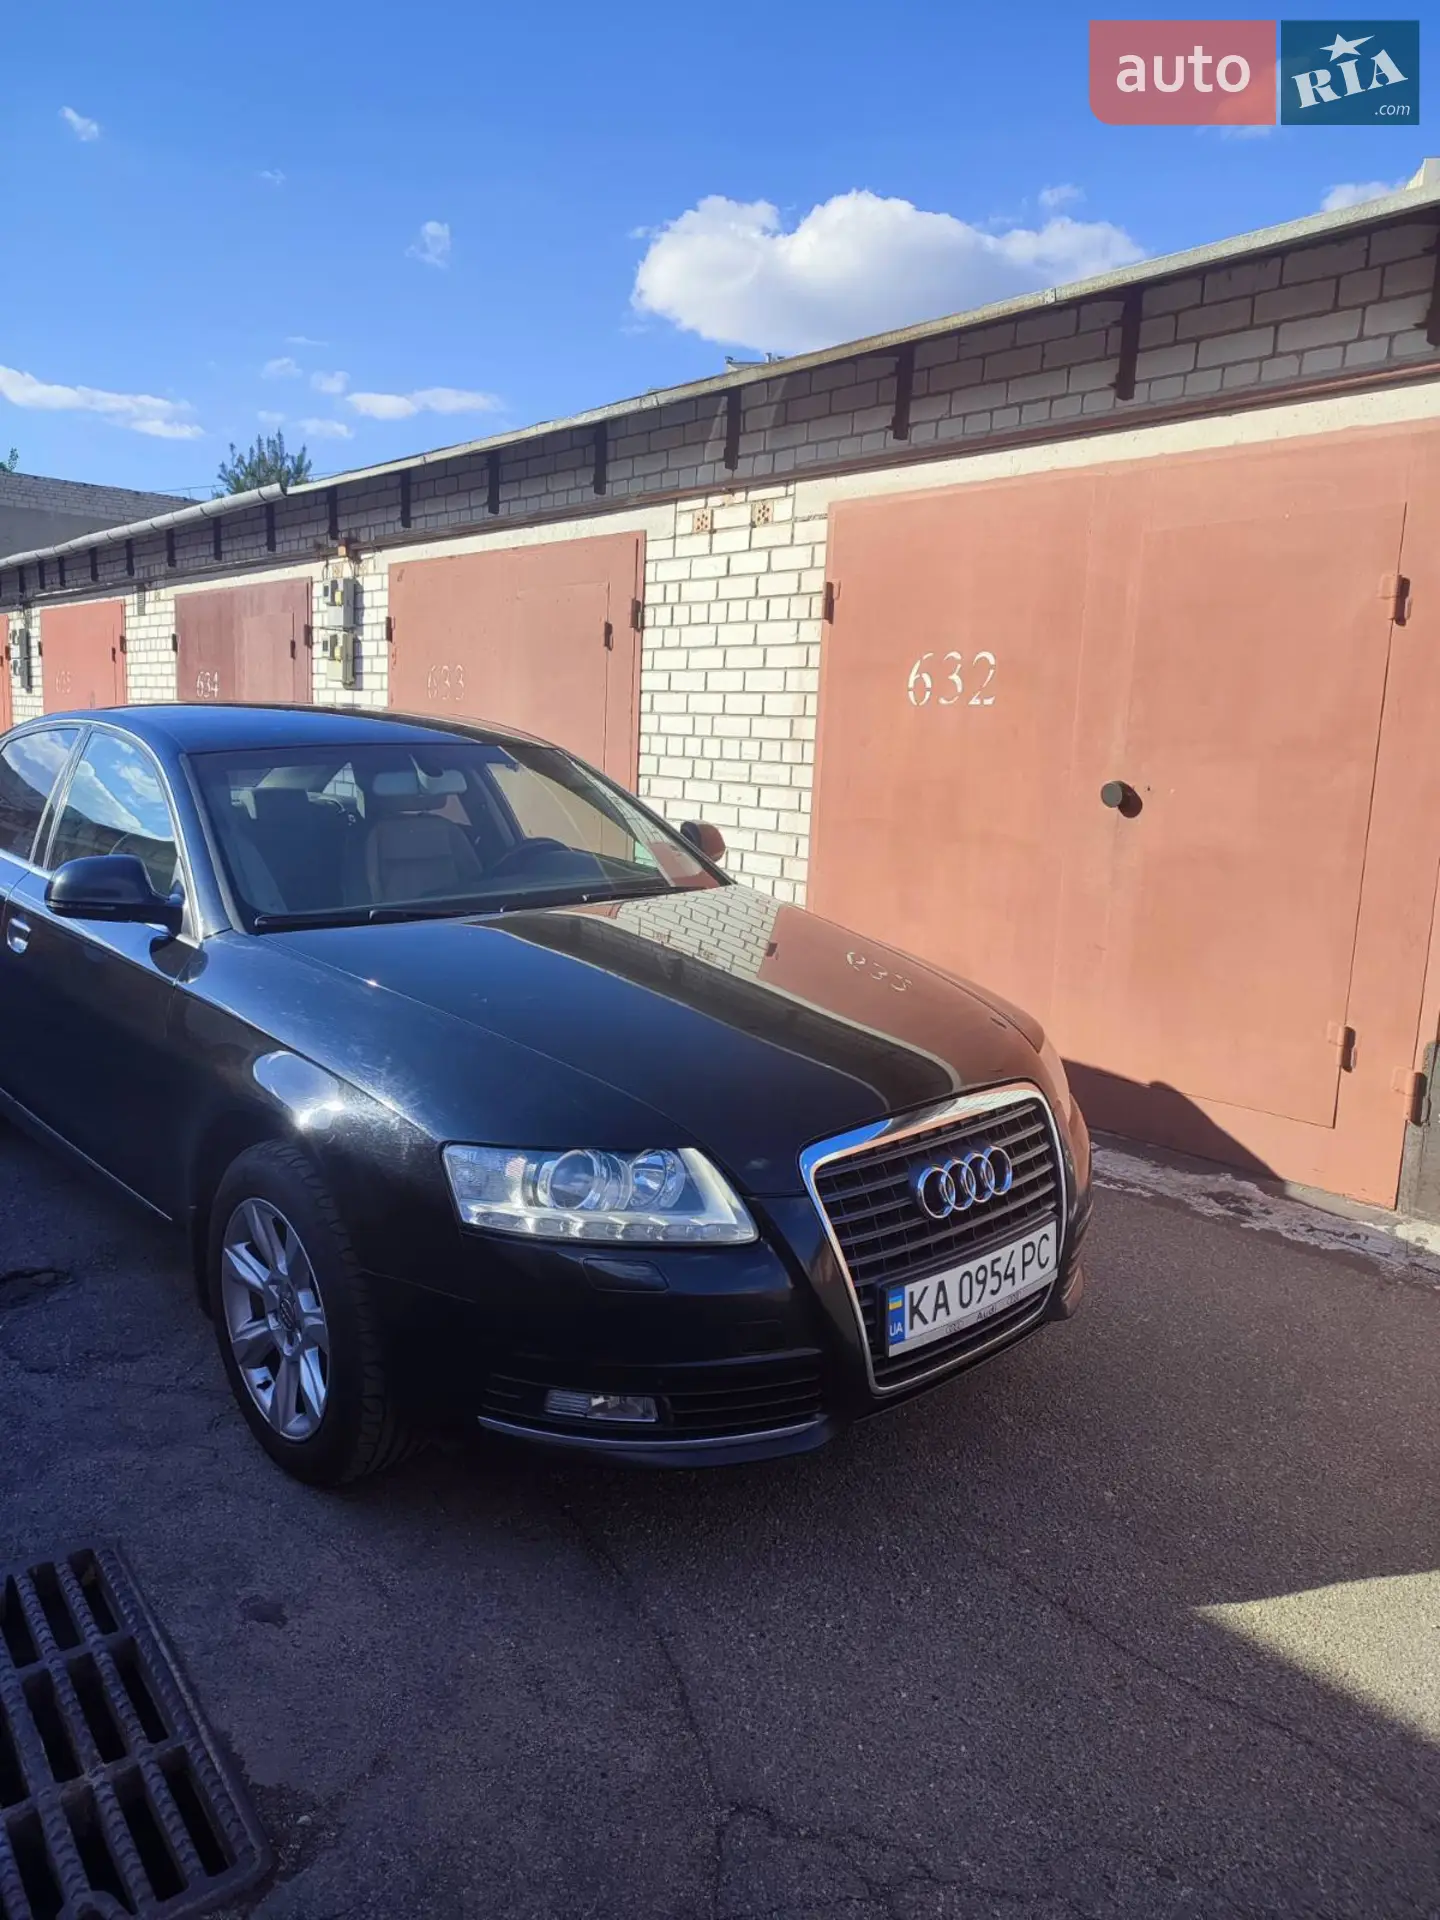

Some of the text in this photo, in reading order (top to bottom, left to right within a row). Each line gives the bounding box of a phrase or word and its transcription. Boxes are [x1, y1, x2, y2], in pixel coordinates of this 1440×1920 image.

[196, 671, 219, 699] 634
[427, 664, 465, 700] 633
[907, 651, 996, 706] 632
[908, 1233, 1050, 1331] KA 0954 PC
[889, 1323, 904, 1338] UA
